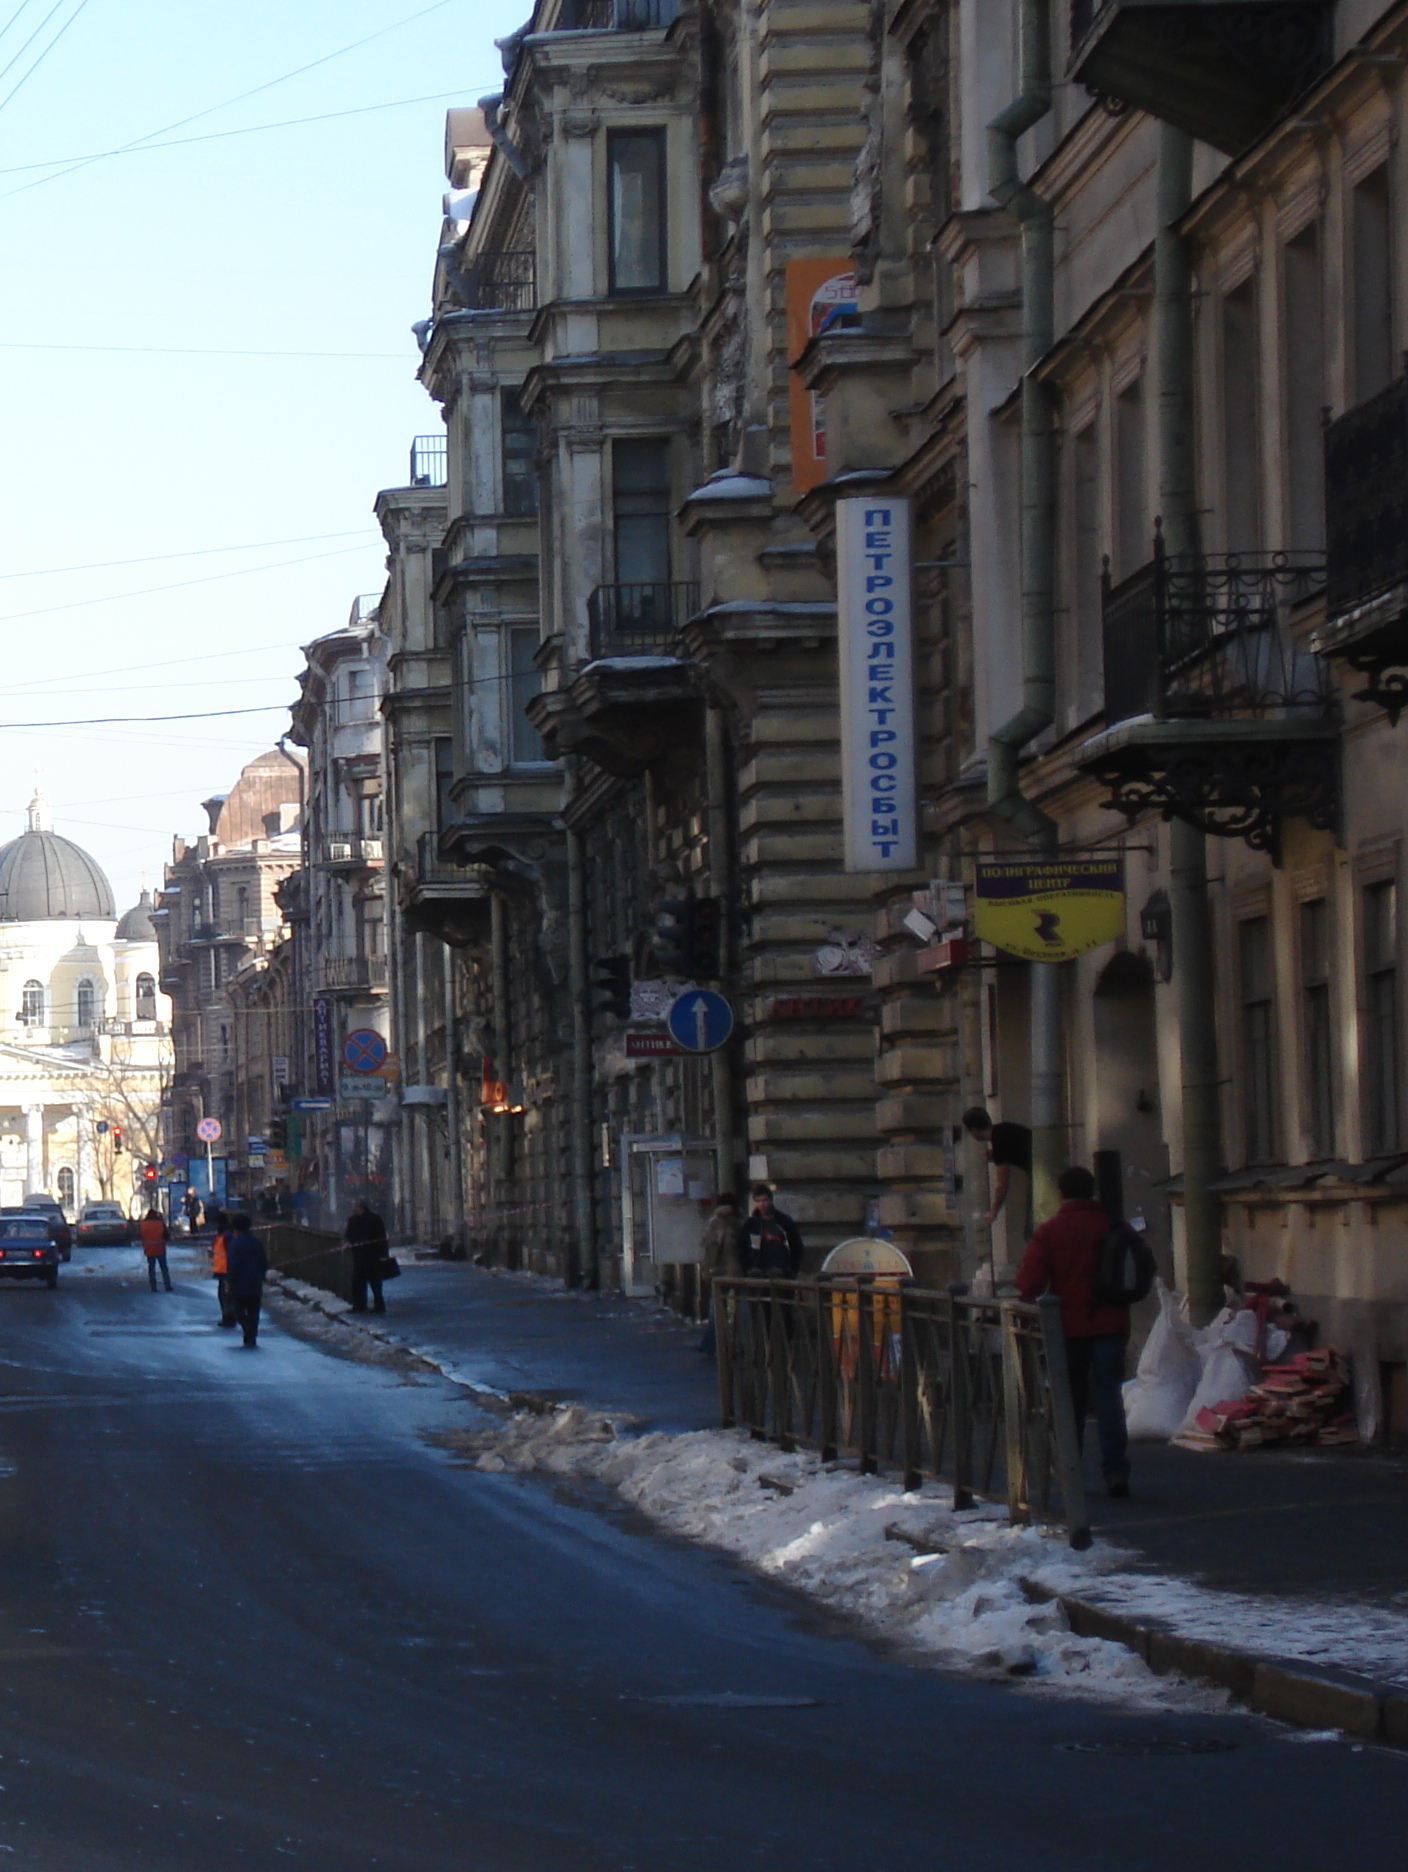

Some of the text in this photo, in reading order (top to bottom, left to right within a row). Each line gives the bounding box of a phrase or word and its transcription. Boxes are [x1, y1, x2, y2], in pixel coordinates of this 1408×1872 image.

[863, 508, 900, 859] ПЕТРОЭЛЕКТРОСБЫТ
[982, 863, 1117, 878] ПОЛИГРАФИЧЕСКИЙ
[1028, 878, 1072, 889] ЦЕНТР
